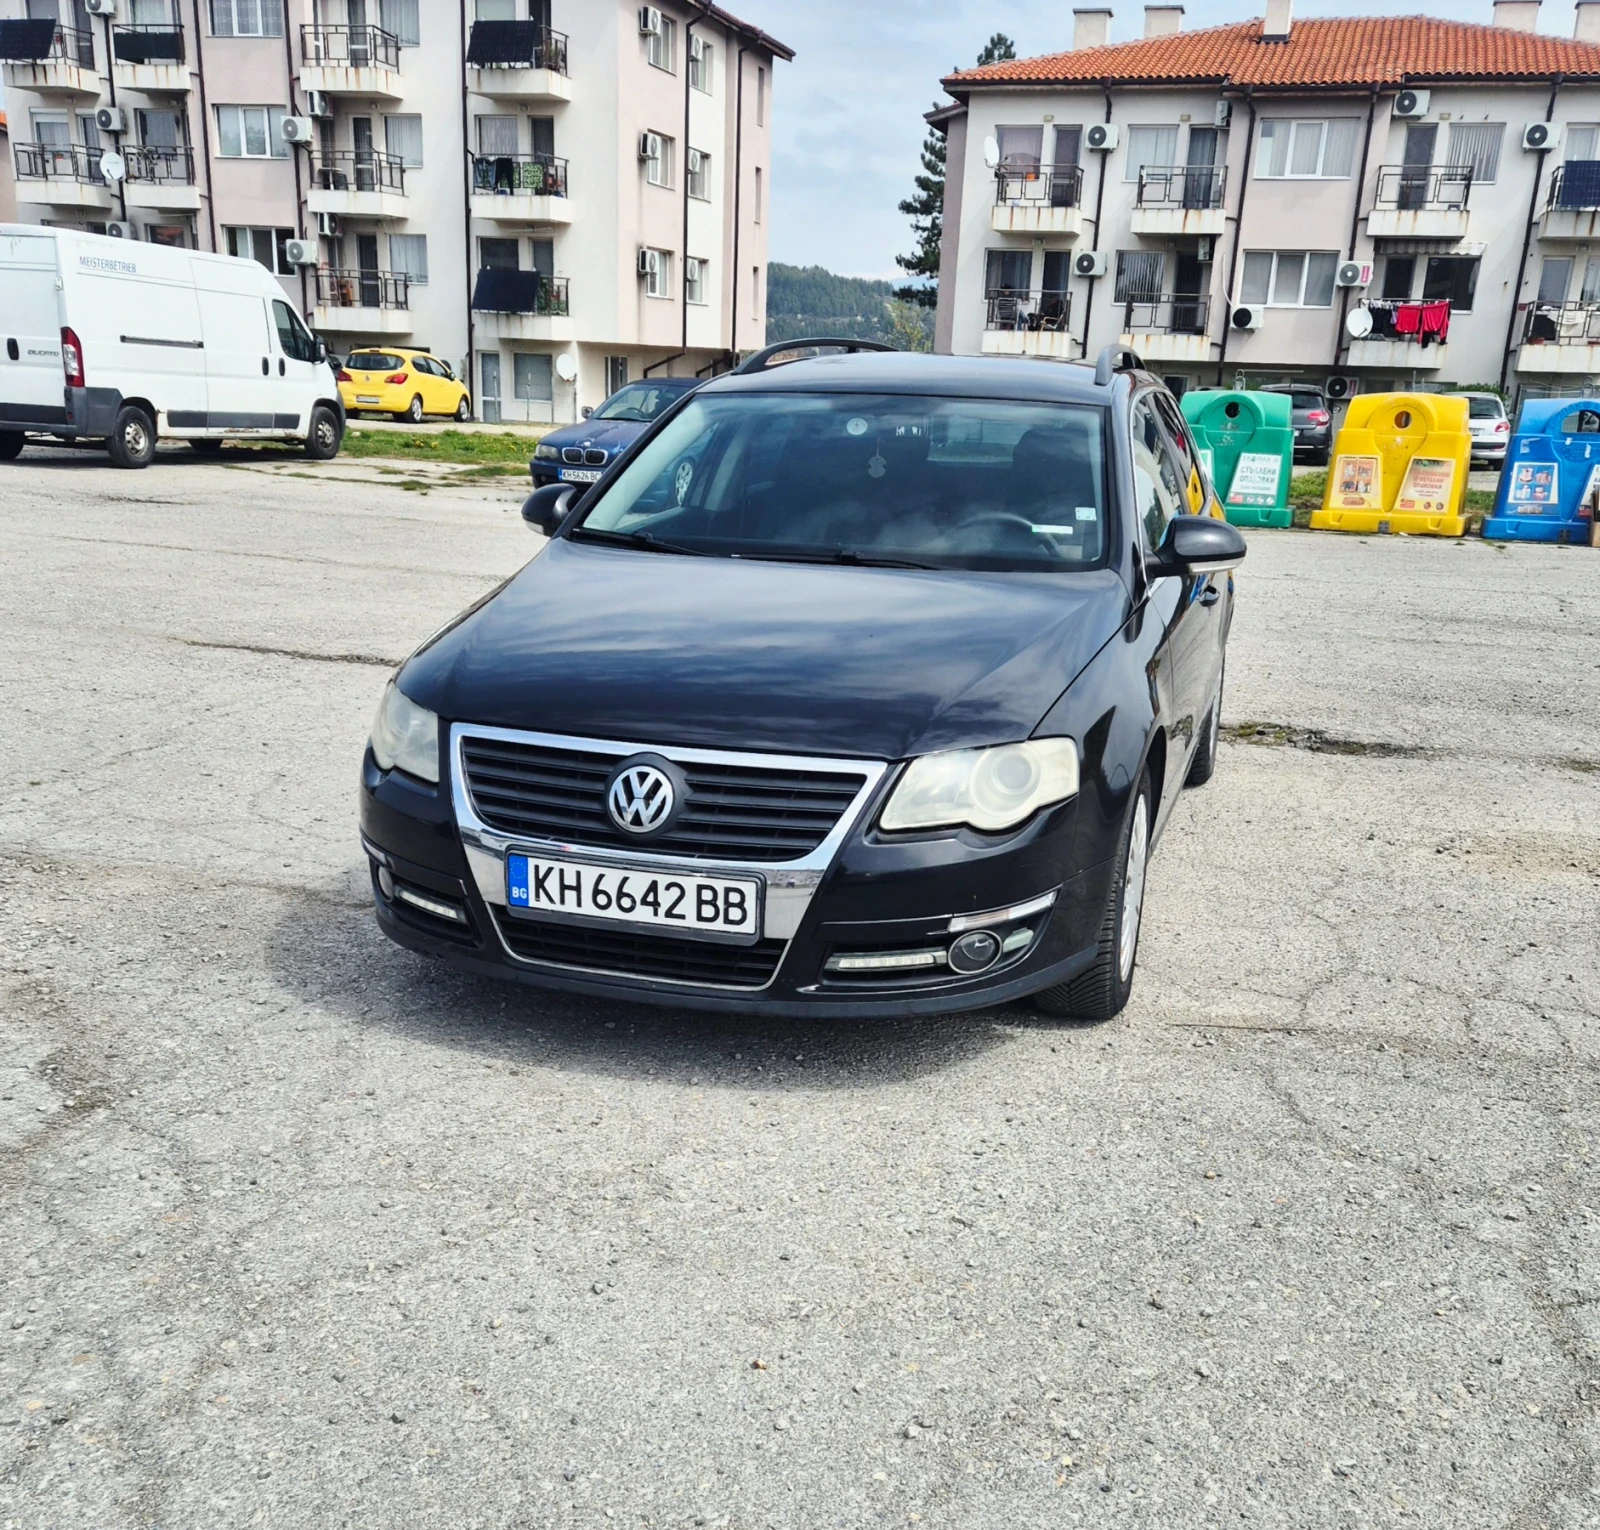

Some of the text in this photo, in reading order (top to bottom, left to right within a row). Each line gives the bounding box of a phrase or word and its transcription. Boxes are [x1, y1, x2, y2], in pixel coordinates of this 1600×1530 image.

[79, 256, 137, 273] MEISTERBETRIEB
[27, 349, 60, 357] DUCATO
[512, 886, 527, 899] BG
[533, 864, 748, 925] KH 6642 BB
